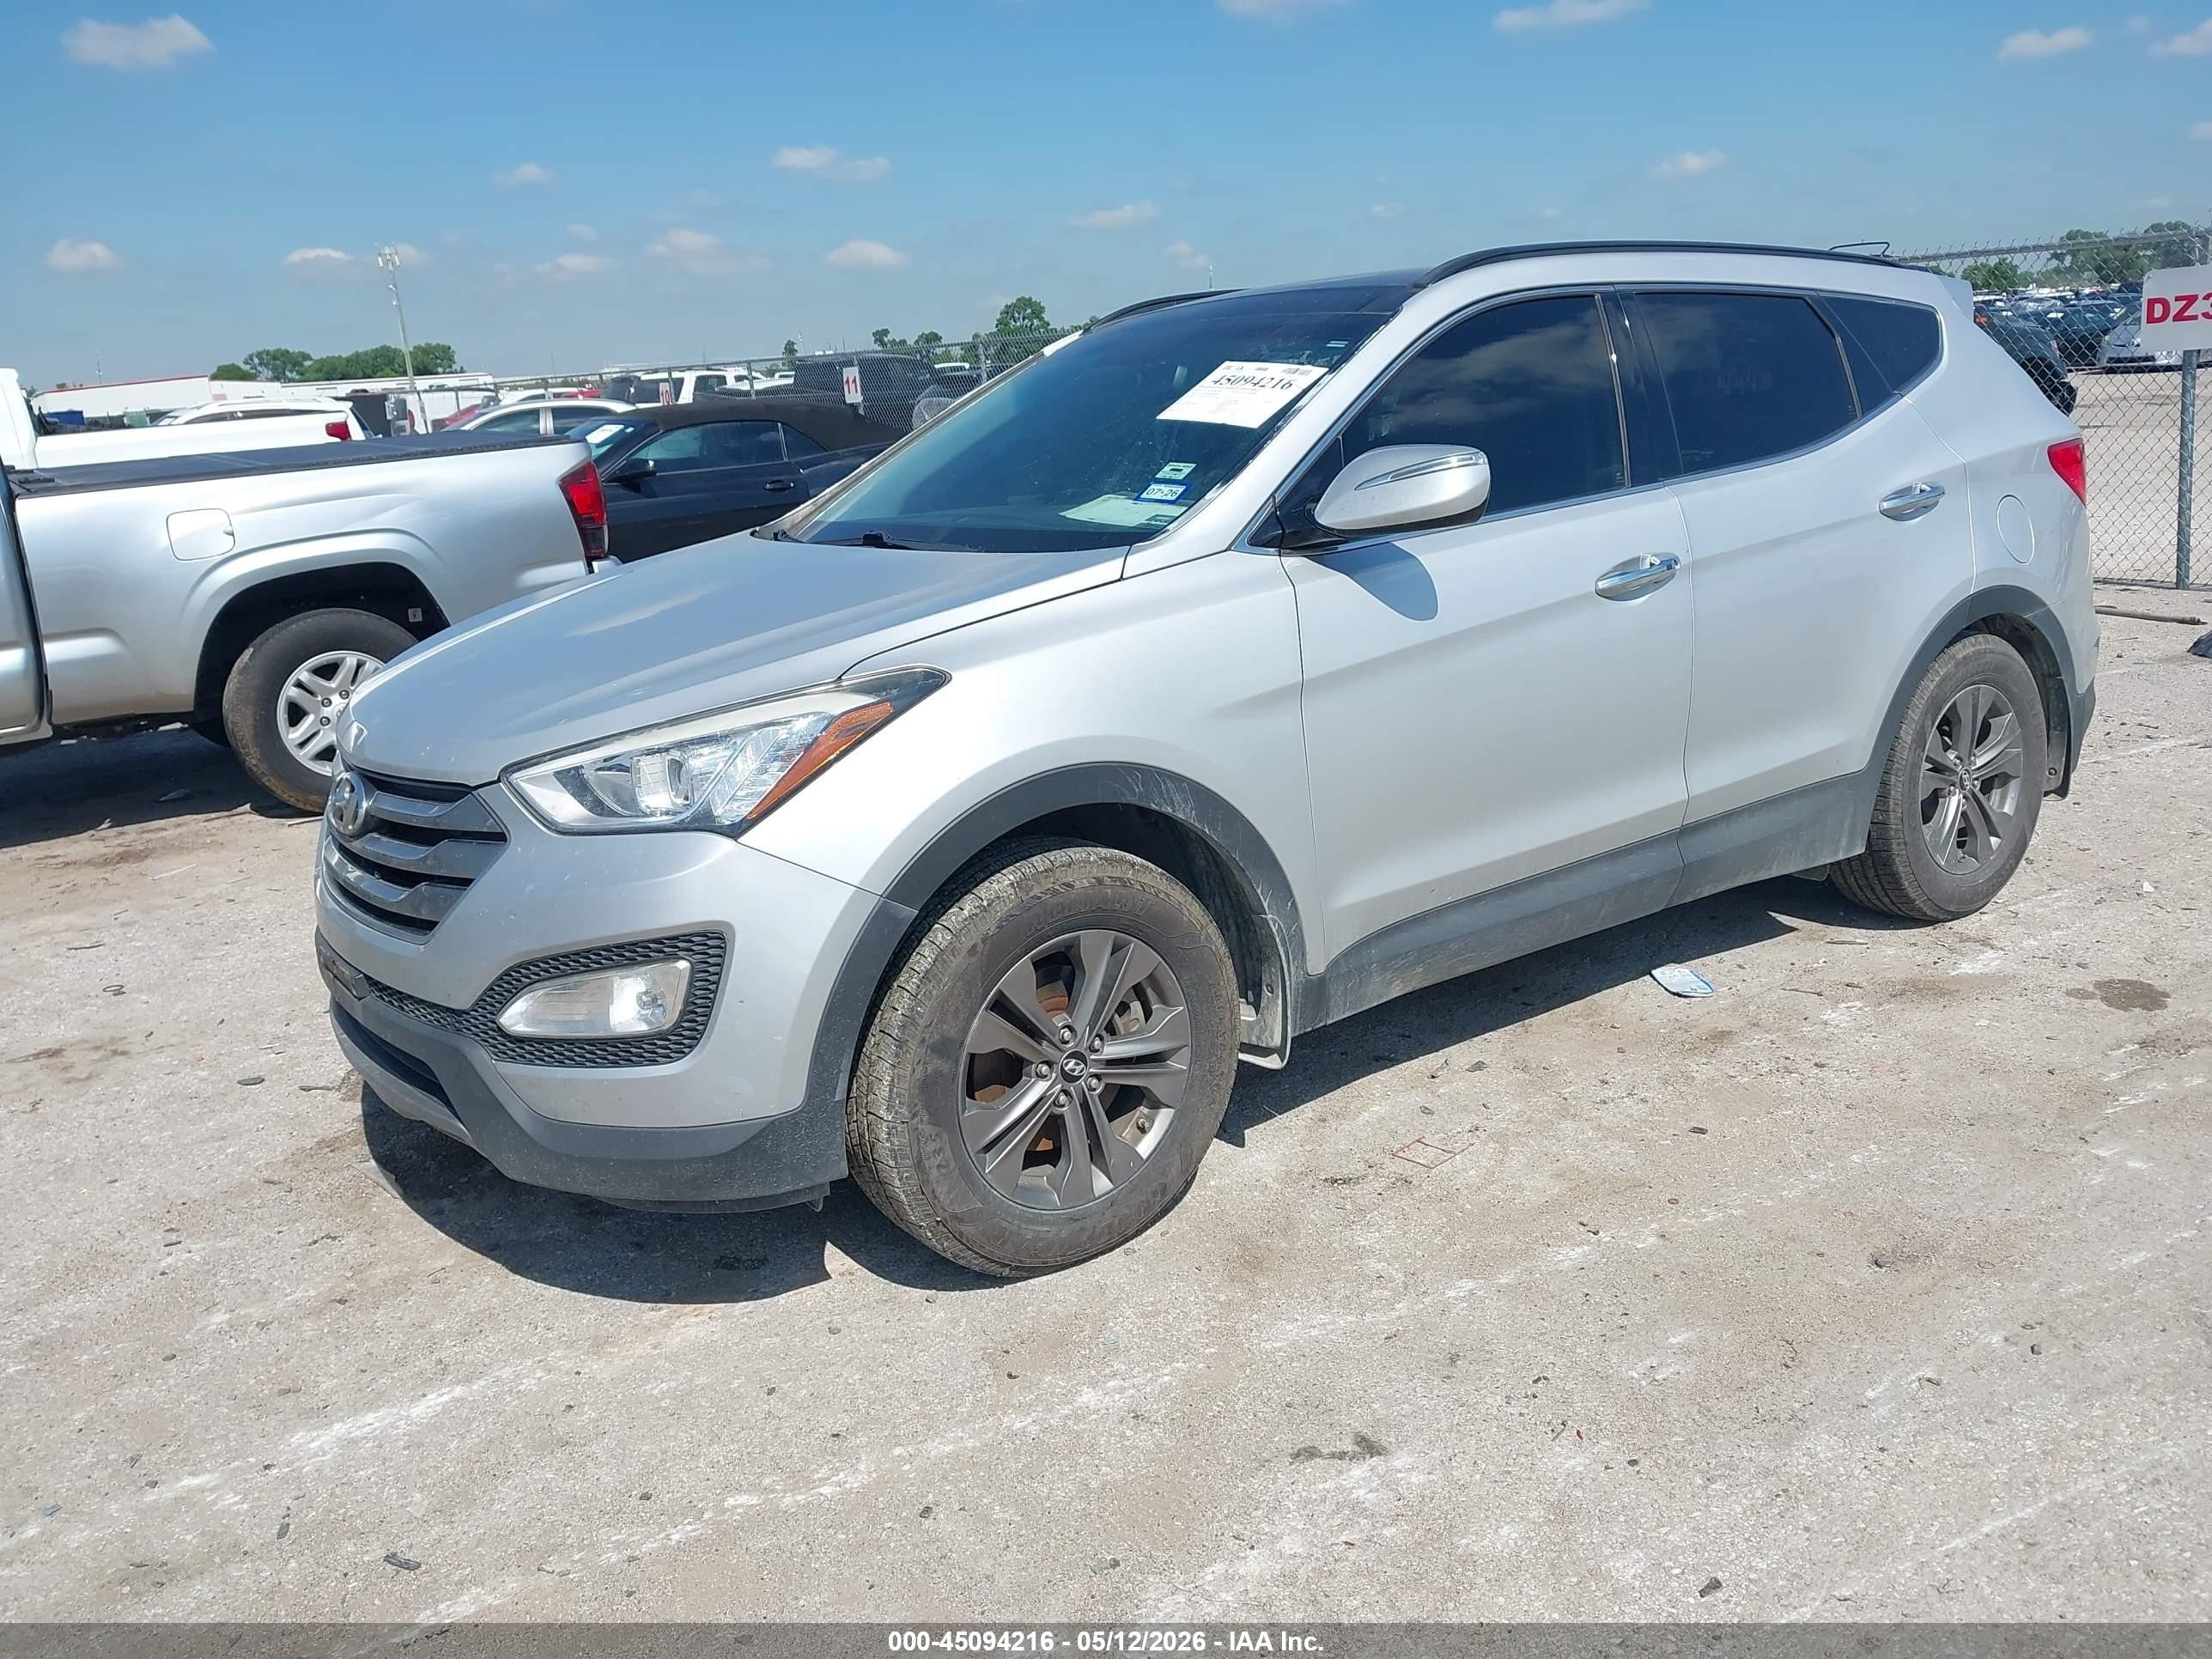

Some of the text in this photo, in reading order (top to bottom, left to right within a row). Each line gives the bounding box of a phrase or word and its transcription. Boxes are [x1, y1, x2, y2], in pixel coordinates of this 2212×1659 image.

[845, 375, 859, 395] 11
[1212, 375, 1294, 390] 45094216
[661, 389, 670, 404] 10
